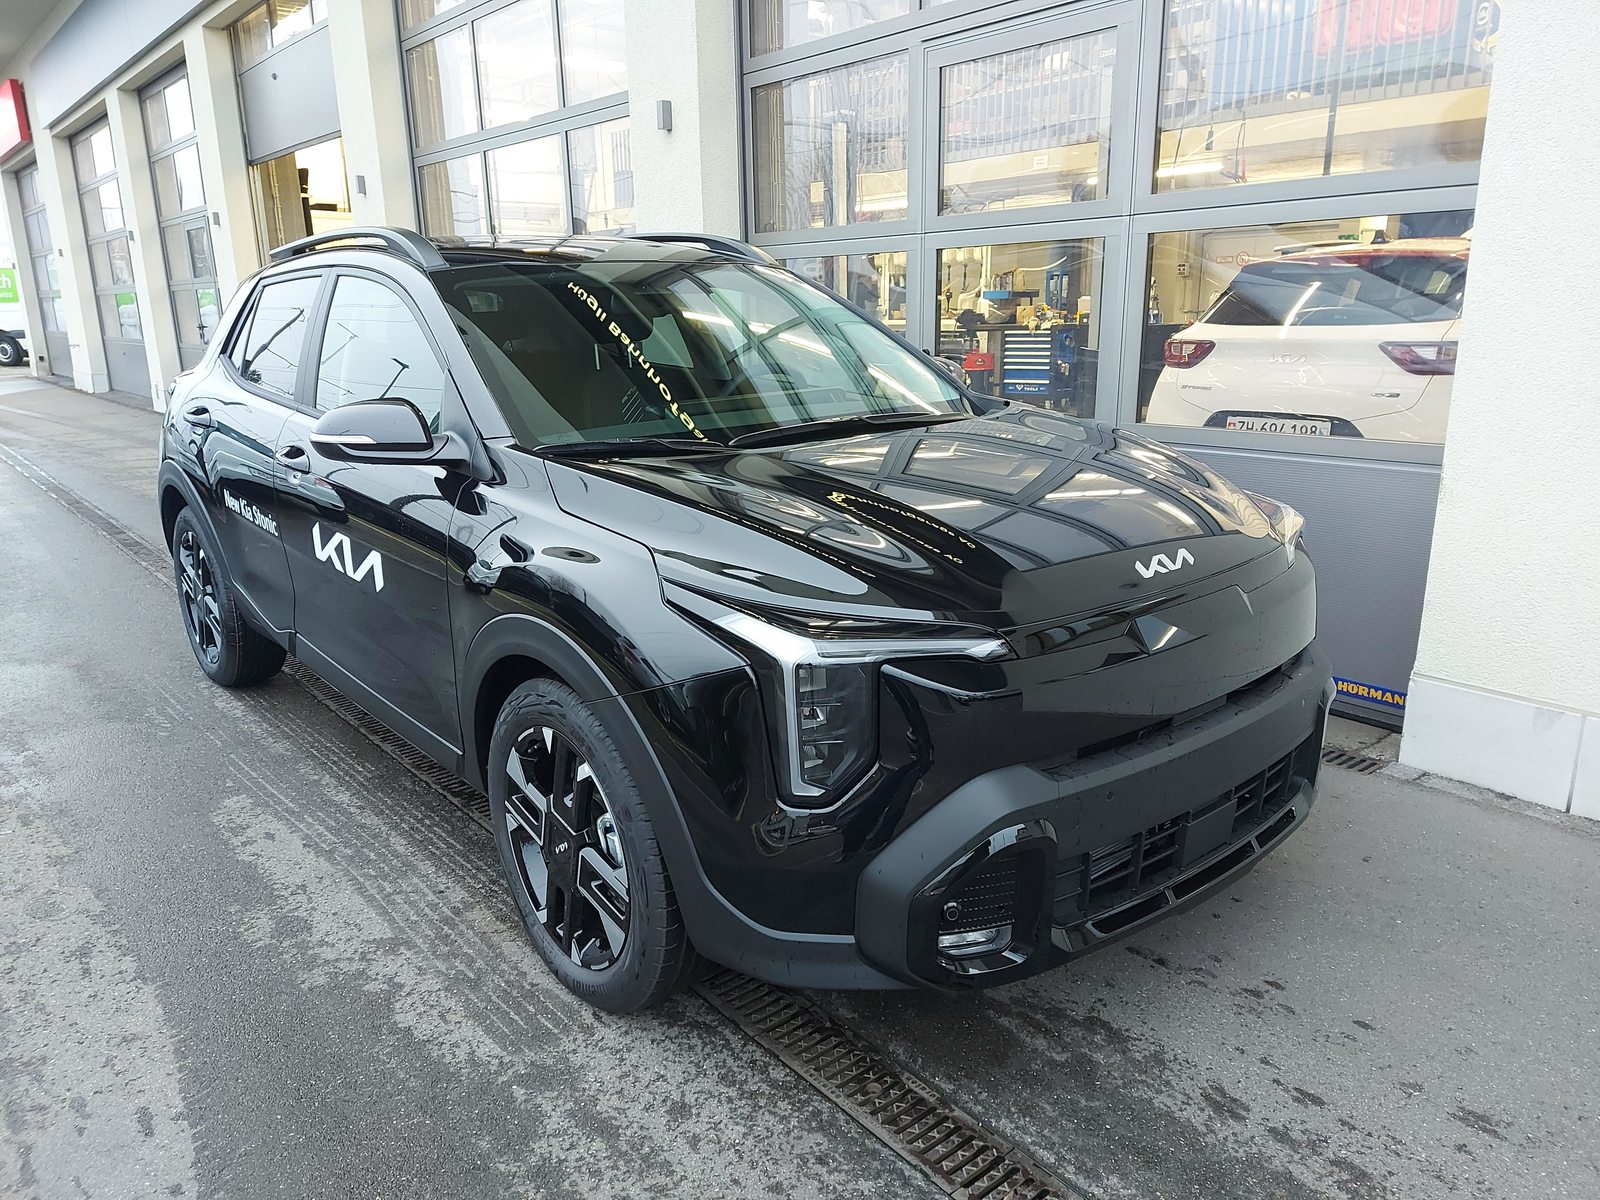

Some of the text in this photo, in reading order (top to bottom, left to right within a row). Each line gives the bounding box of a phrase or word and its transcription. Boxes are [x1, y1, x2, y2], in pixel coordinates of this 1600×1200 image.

[223, 488, 279, 537] New Kia Stonic
[312, 521, 385, 593] KIA
[1134, 547, 1195, 579] KIA
